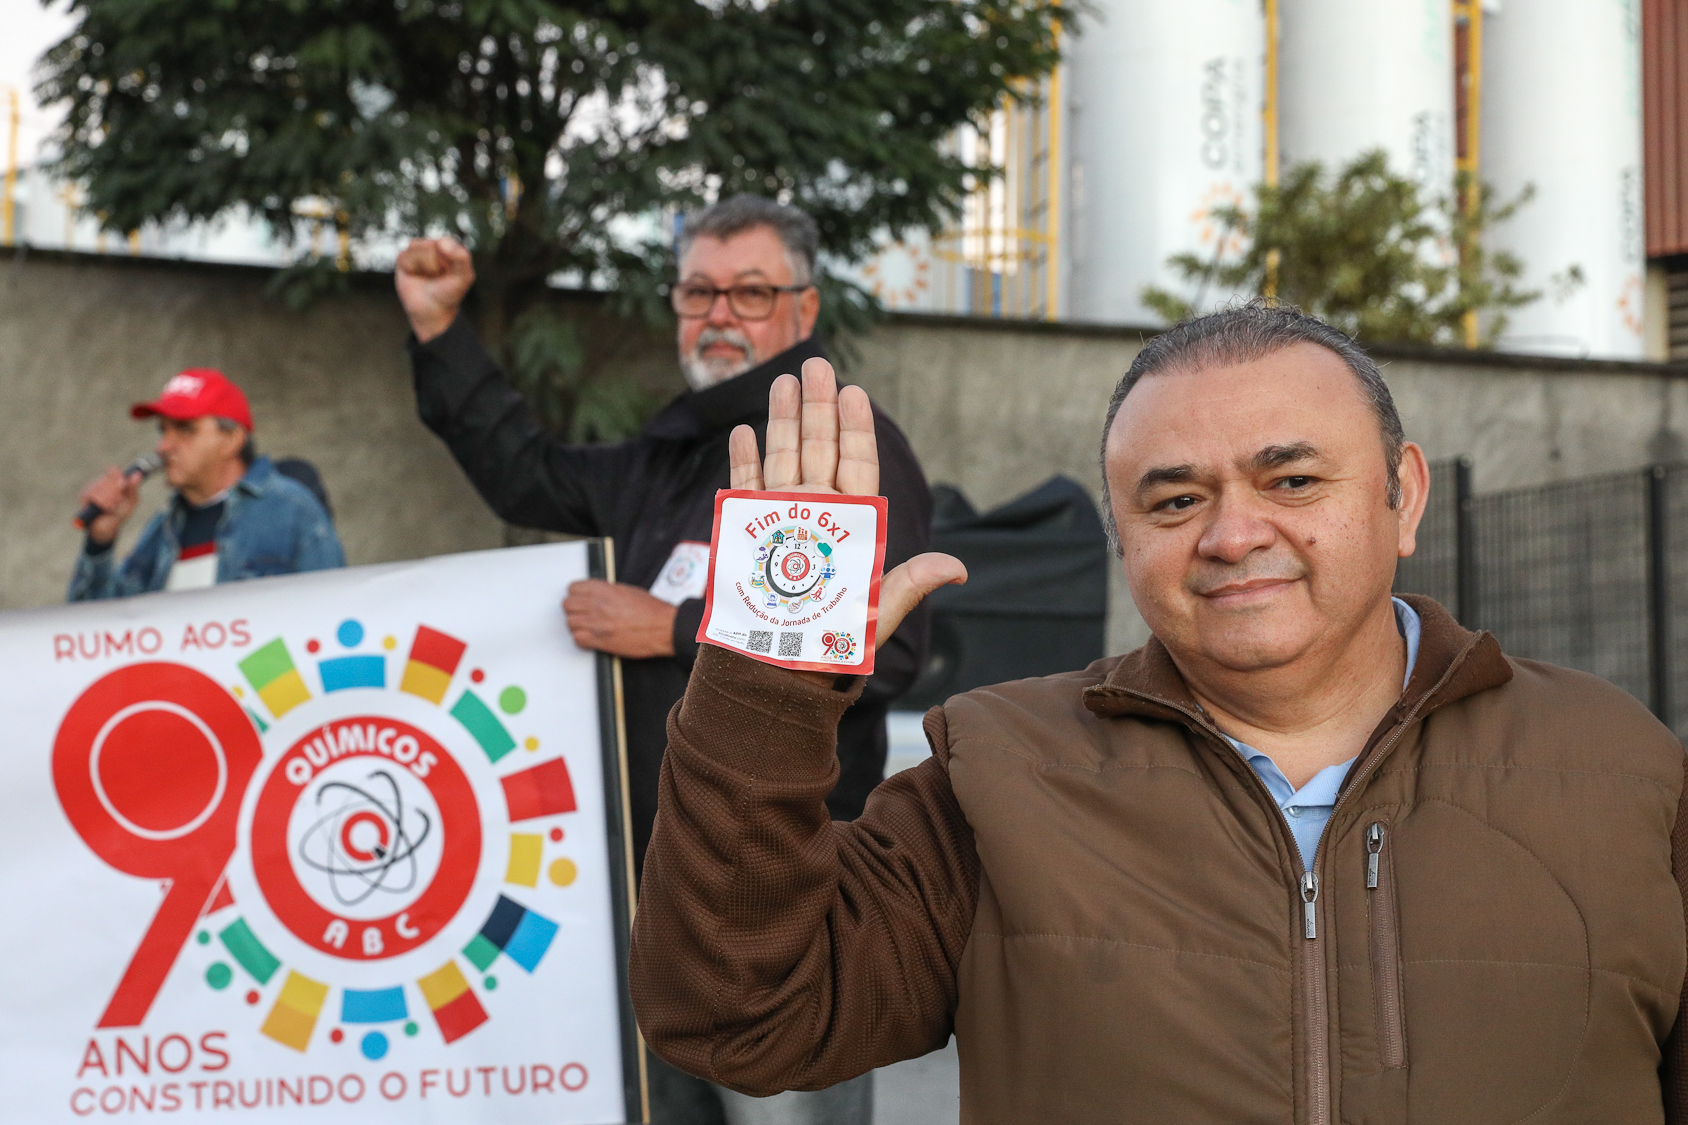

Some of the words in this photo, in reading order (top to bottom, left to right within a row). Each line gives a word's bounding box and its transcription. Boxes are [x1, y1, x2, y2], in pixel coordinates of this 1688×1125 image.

[745, 511, 781, 539] Fim
[788, 503, 811, 520] do
[818, 511, 851, 543] 6x1
[735, 581, 745, 597] com
[742, 595, 769, 621] Redução
[769, 616, 779, 625] da
[781, 616, 811, 627] Jornada
[812, 612, 822, 621] de
[821, 587, 848, 614] Trabalho
[54, 627, 163, 663] RUMO
[180, 619, 252, 652] AOS
[285, 724, 440, 787] QUÍMICOS
[76, 1031, 231, 1079] ANOS
[69, 1073, 366, 1117] CONSTRUINDO
[380, 1070, 408, 1100] O
[418, 1062, 590, 1099] FUTURO
